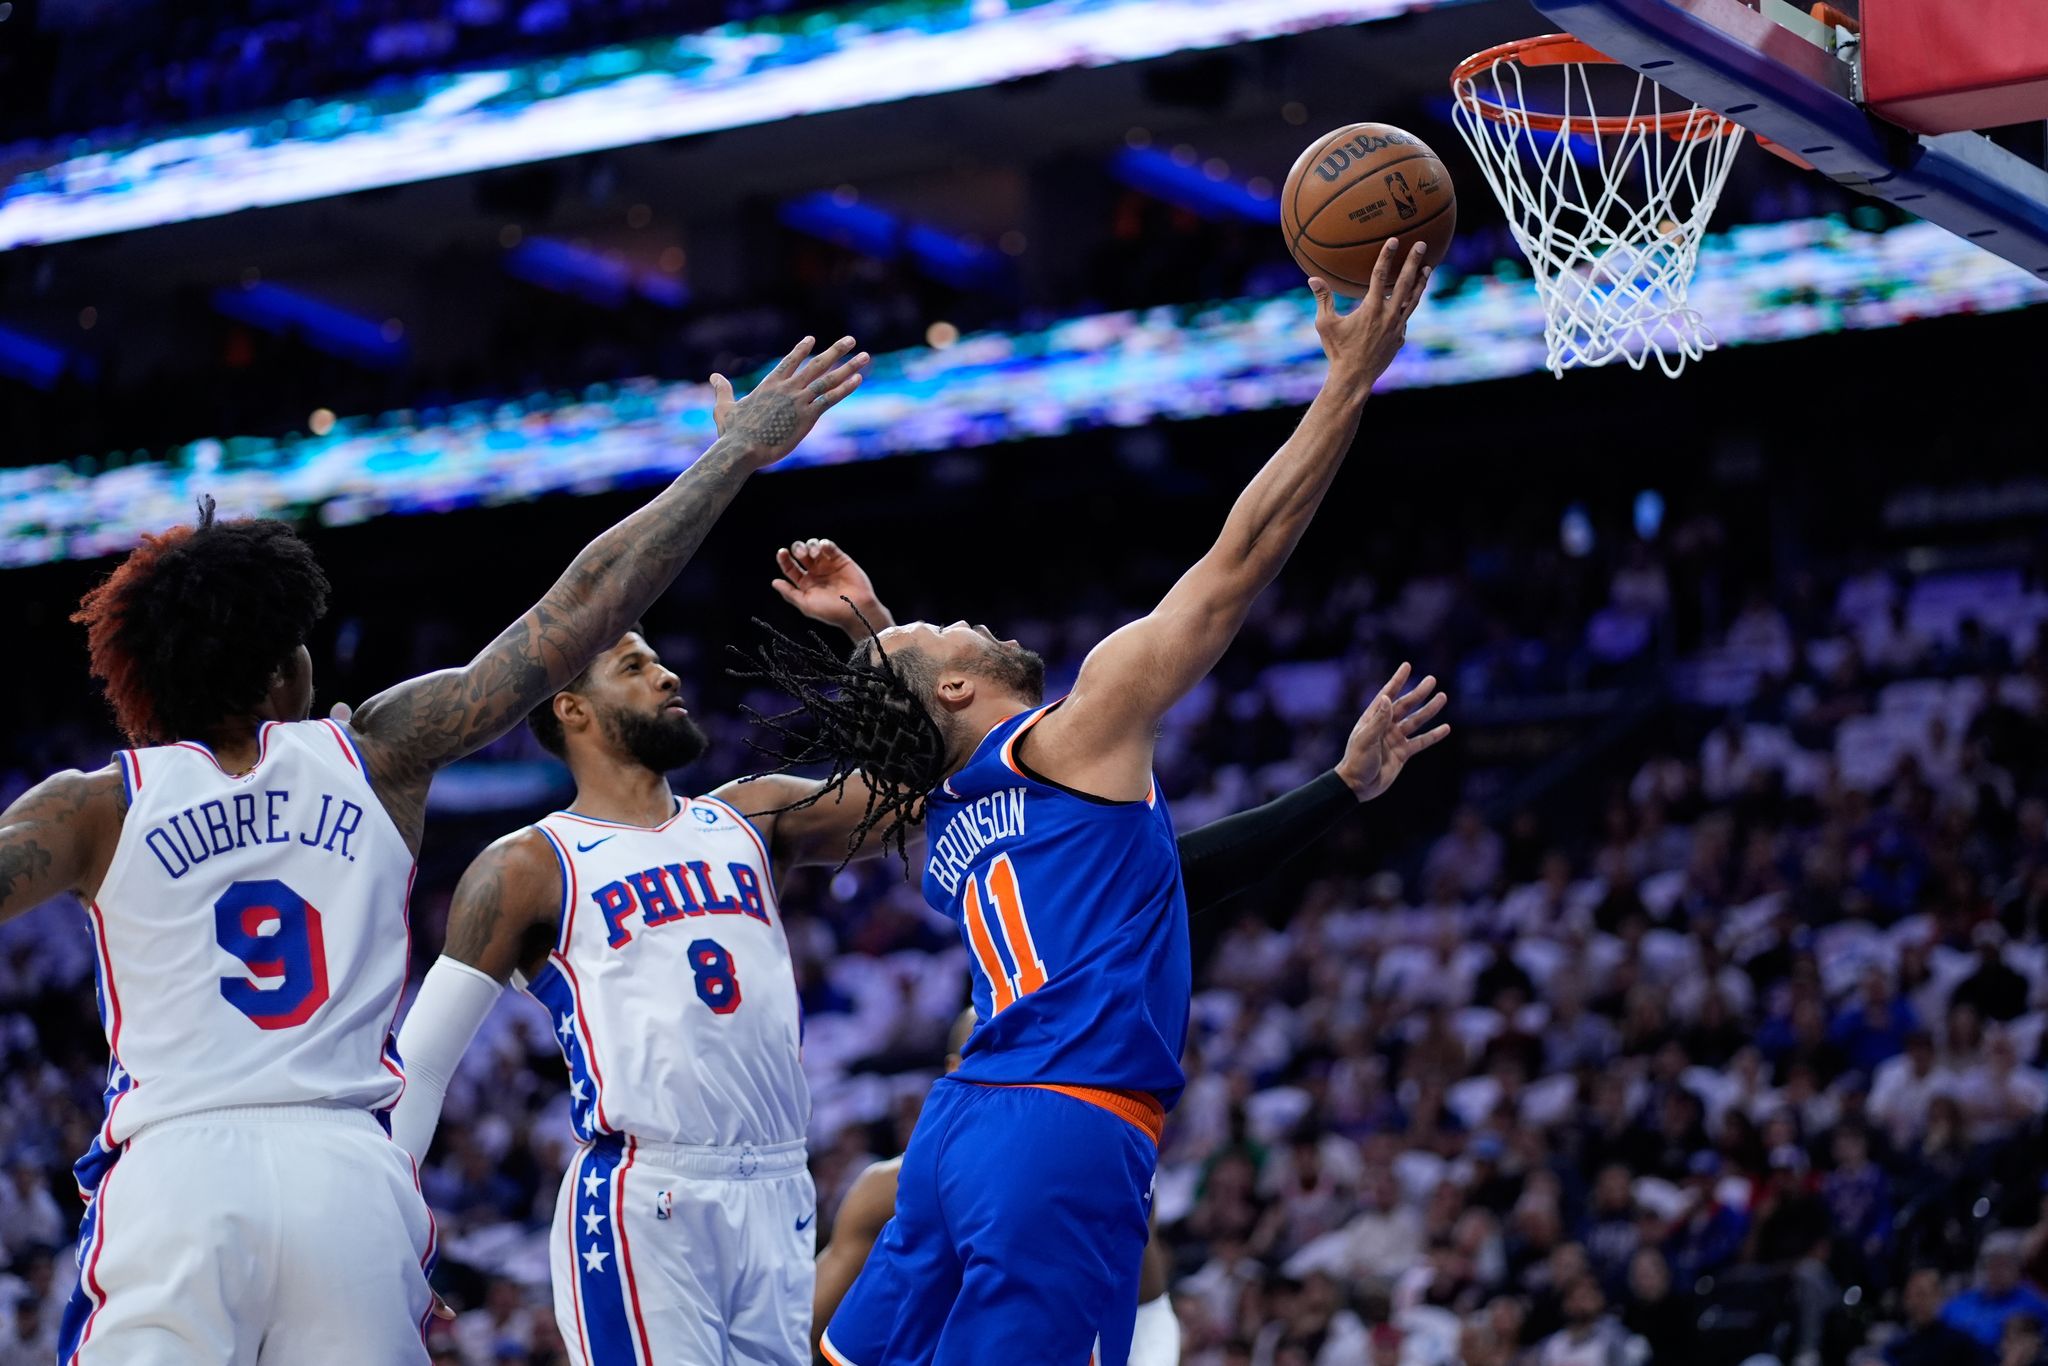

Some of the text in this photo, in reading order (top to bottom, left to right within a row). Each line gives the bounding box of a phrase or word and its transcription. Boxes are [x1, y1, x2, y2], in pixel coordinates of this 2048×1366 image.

[145, 790, 363, 879] OUBRE JR.
[928, 787, 1027, 897] BRUNSON
[214, 879, 330, 1030] 9
[591, 860, 771, 950] PHILA
[963, 851, 1049, 1018] 11
[687, 938, 742, 1014] 8
